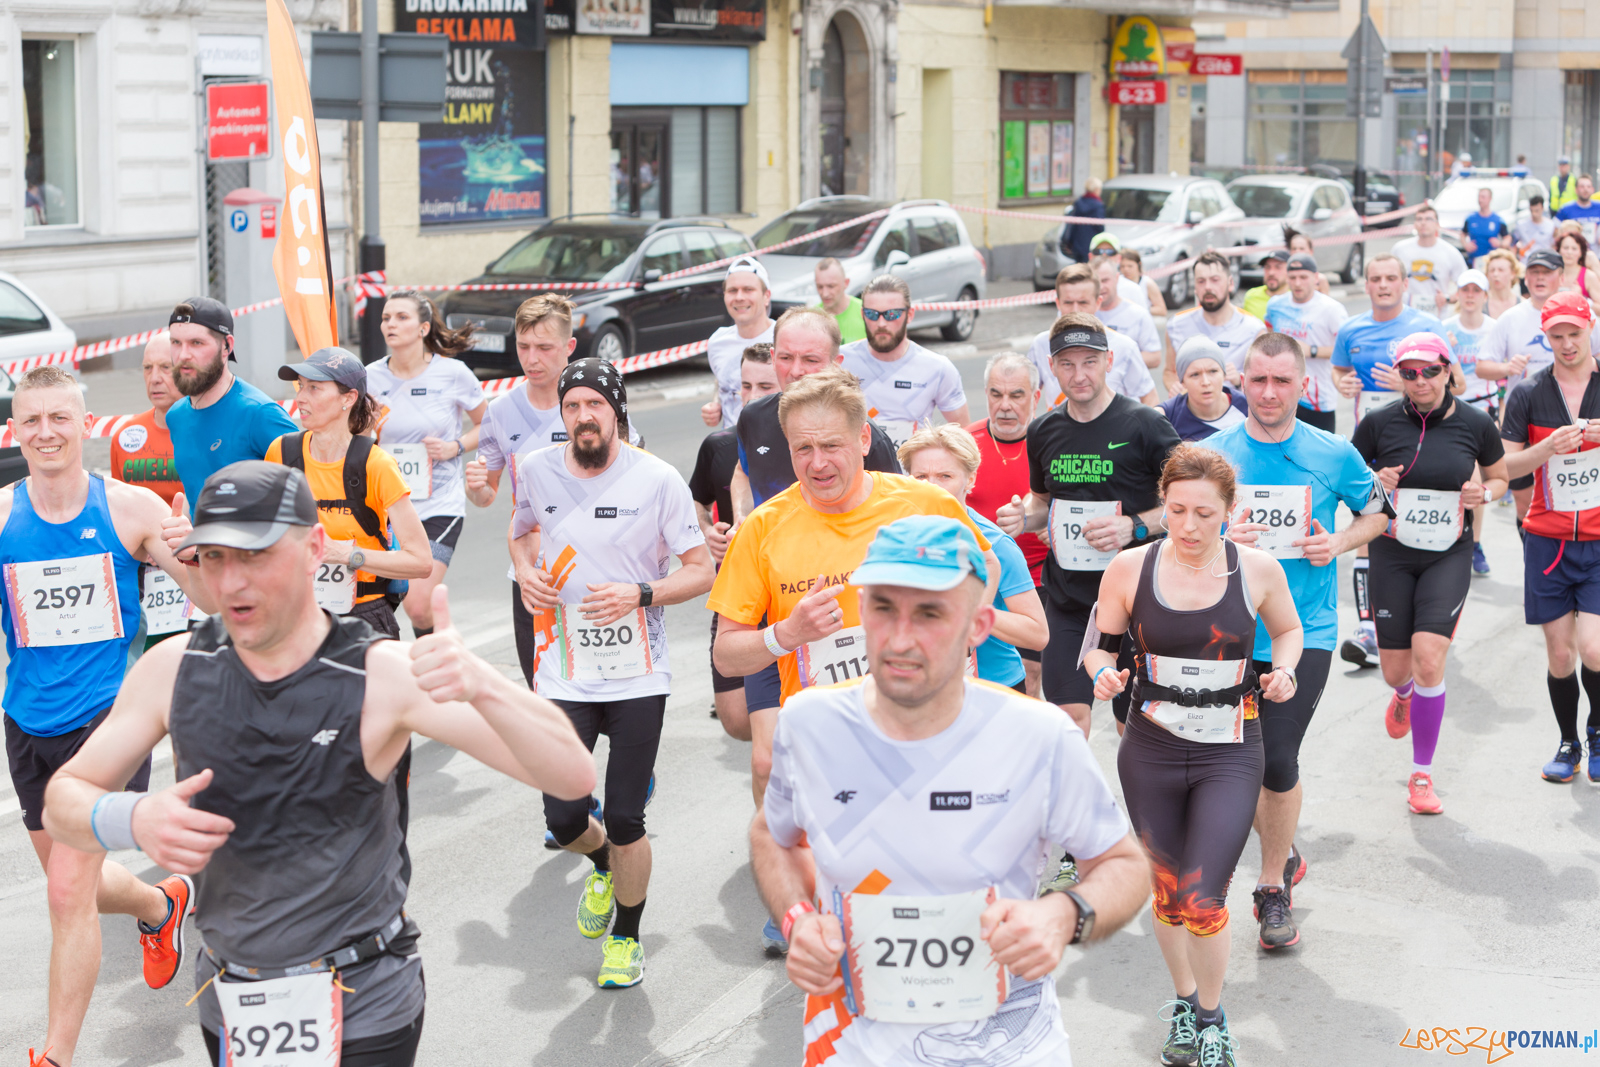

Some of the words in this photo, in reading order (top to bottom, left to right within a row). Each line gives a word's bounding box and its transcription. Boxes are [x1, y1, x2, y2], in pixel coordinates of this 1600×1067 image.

[416, 18, 516, 42] REKLAMA
[1118, 88, 1156, 103] 6-23
[216, 106, 261, 118] Automat
[210, 123, 267, 138] parkingowy
[756, 445, 770, 455] 4F
[1050, 460, 1113, 475] CHICAGO
[1059, 475, 1101, 483] MARATHON
[1556, 468, 1599, 487] 9569
[544, 506, 557, 514] 4F
[1405, 509, 1452, 525] 4284
[1063, 523, 1085, 541] 19
[33, 584, 95, 610] 2597
[146, 588, 185, 609] 2832
[59, 612, 76, 620] Artur
[577, 625, 633, 647] 3320
[593, 650, 621, 658] Krzysztof
[1187, 712, 1204, 720] Eliza
[311, 729, 339, 746] 4F
[834, 790, 857, 803] 4F
[935, 795, 970, 806] 11.PKO
[874, 936, 974, 968] 2709
[901, 975, 954, 987] Wojciech
[230, 1019, 319, 1057] 6925
